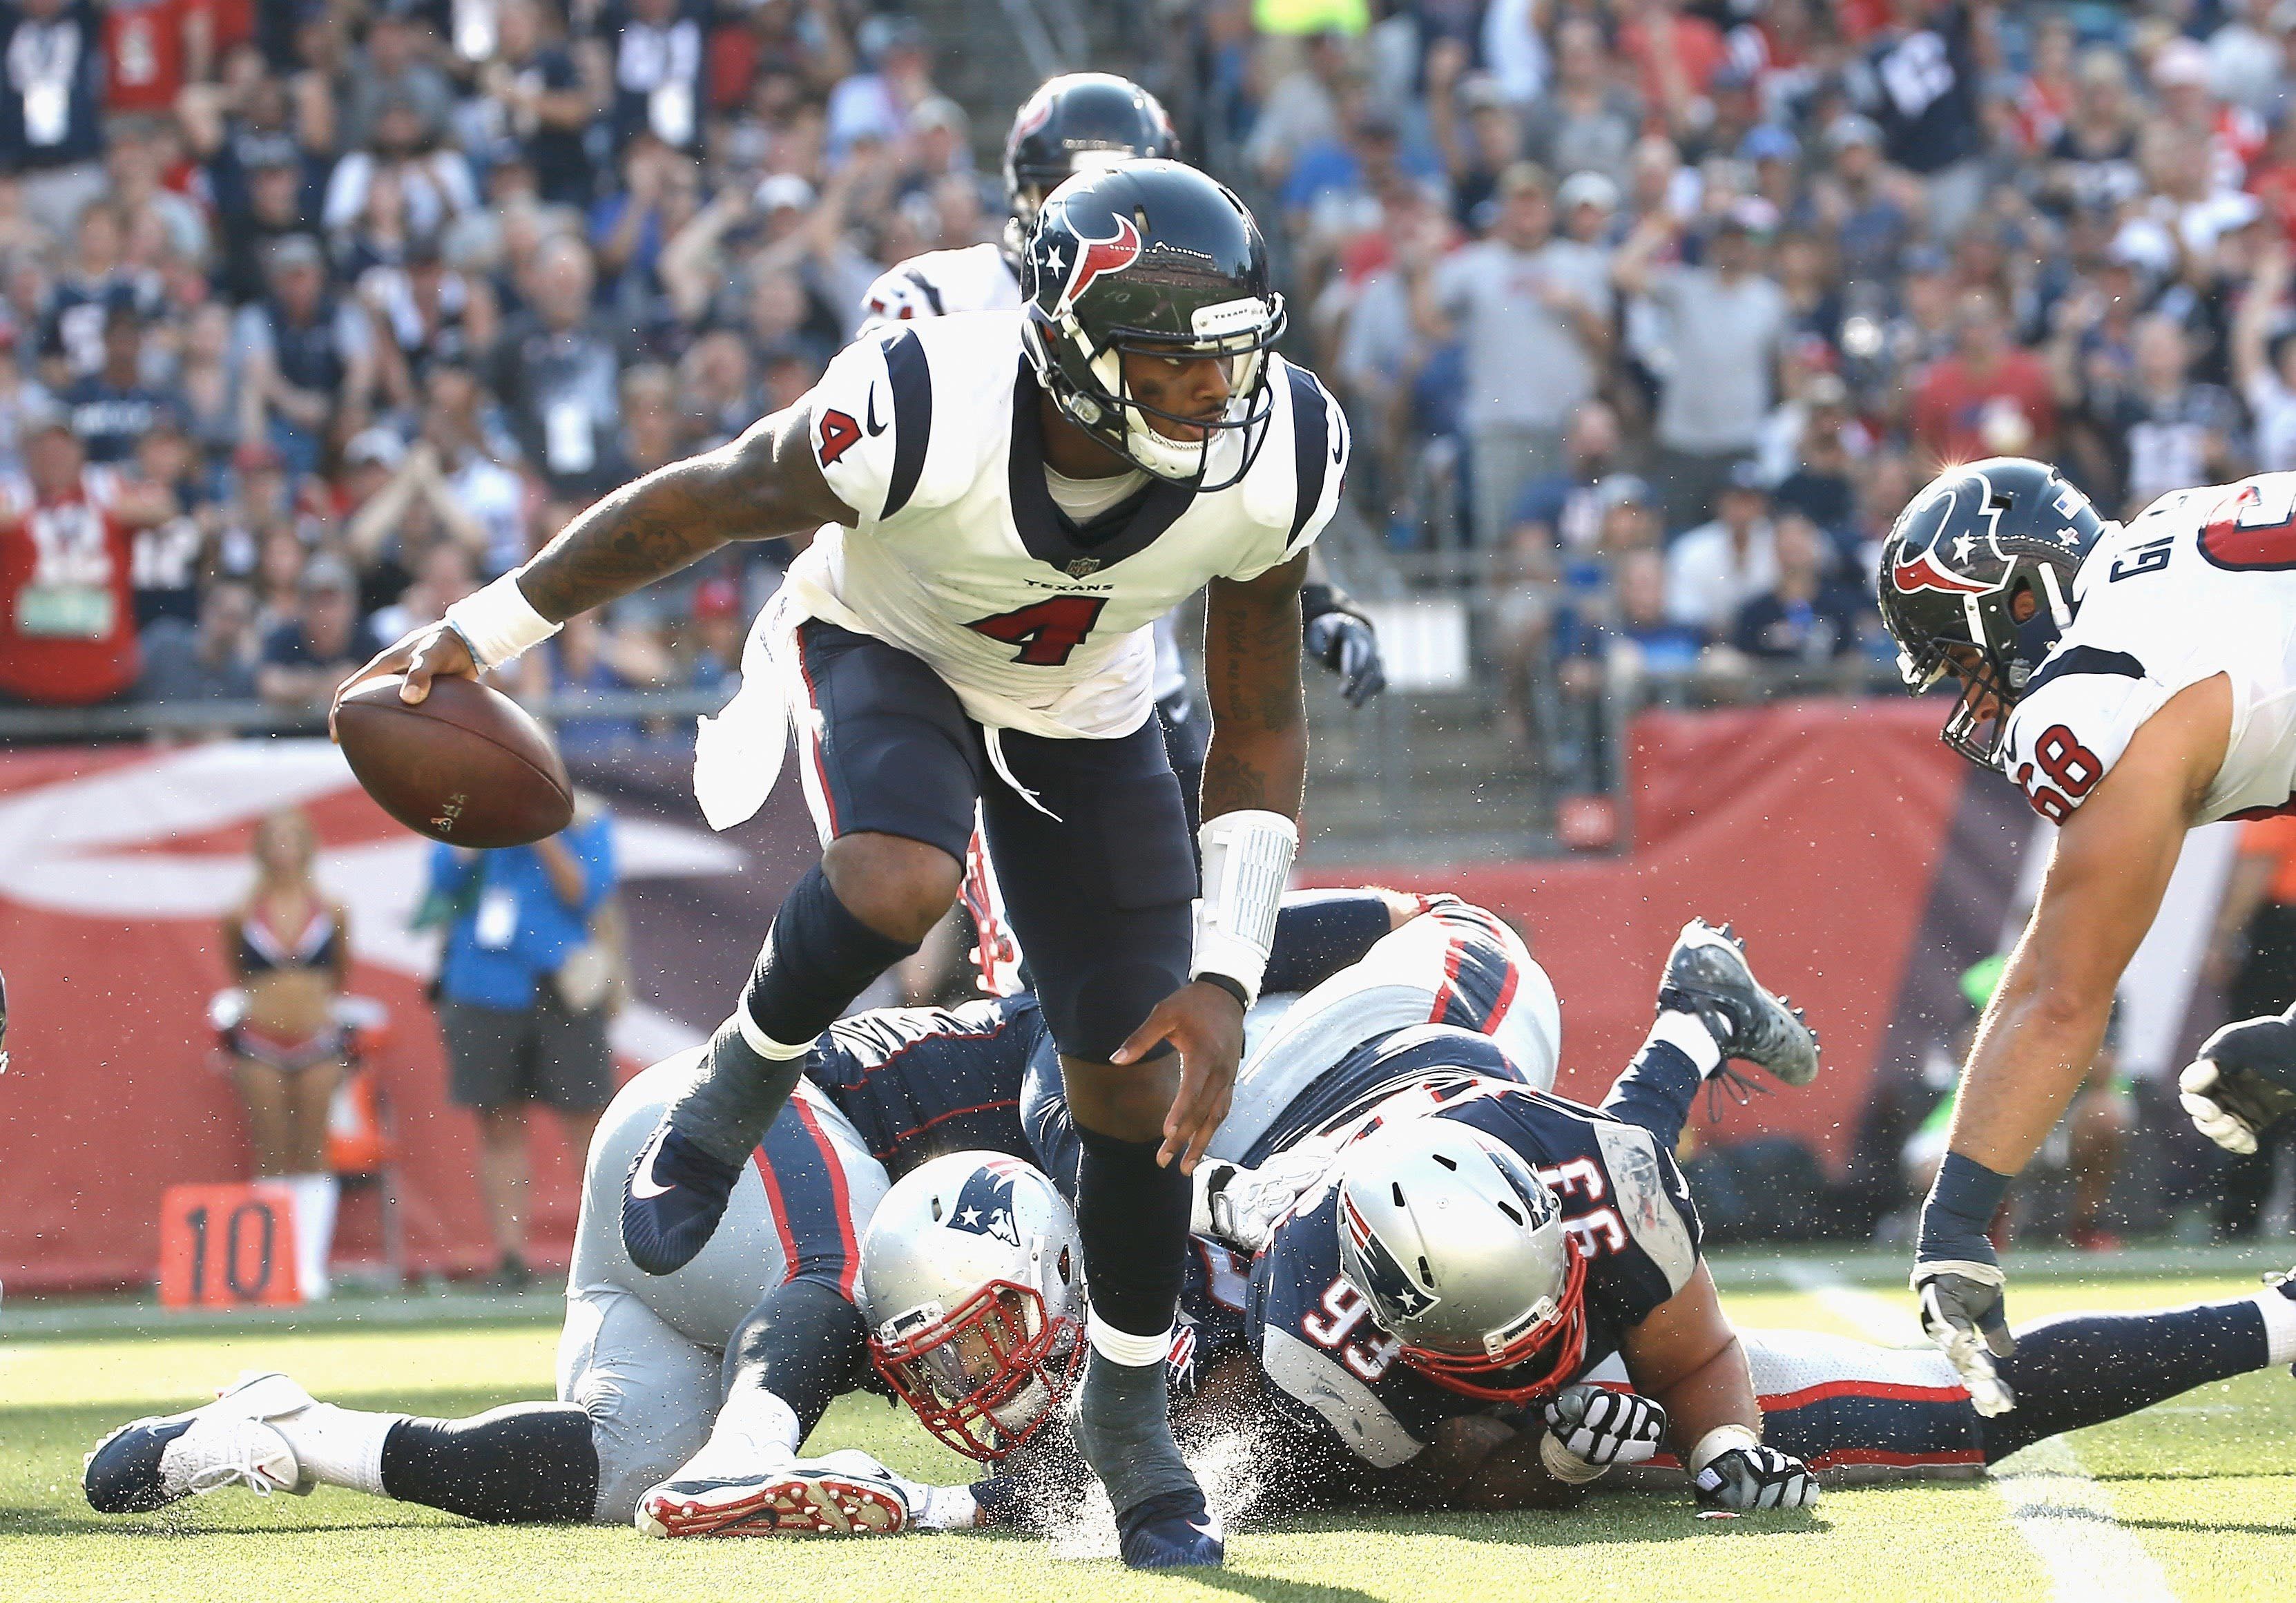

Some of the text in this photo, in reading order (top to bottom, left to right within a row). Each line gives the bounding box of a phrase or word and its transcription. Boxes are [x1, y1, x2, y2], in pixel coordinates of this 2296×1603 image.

[818, 407, 863, 469] 4
[956, 594, 1110, 666] 4
[1023, 578, 1115, 591] TEXANS
[2017, 724, 2103, 827] 68
[186, 1202, 273, 1303] 10
[1536, 1155, 1630, 1262] 93
[1301, 1274, 1402, 1382] 93
